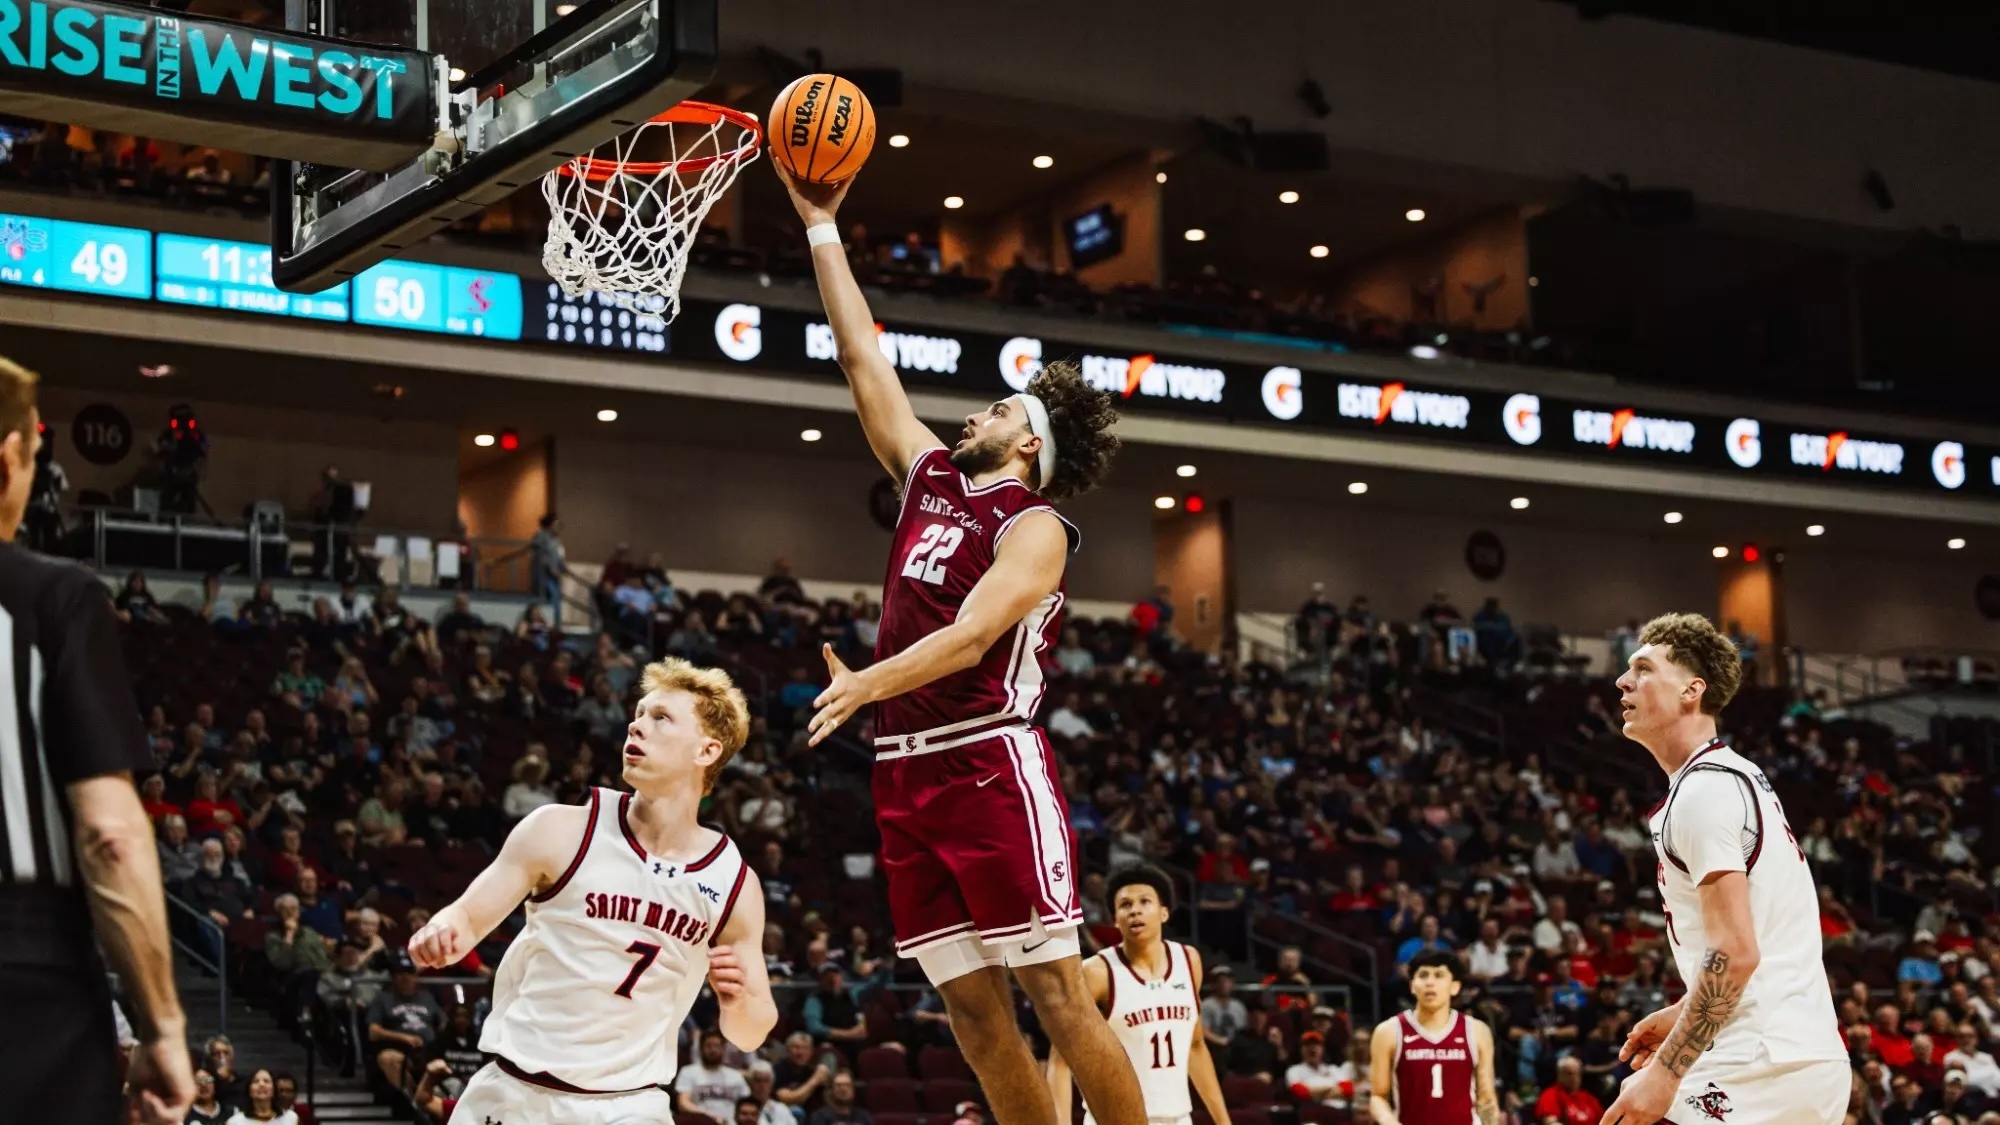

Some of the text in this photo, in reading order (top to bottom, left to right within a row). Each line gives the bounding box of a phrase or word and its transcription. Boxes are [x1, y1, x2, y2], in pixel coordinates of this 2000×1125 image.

[0, 0, 406, 119] RISE IN THE WEST
[791, 81, 825, 147] Wilson
[827, 95, 852, 146] NCAA
[71, 240, 128, 286] 49
[201, 244, 273, 288] 11:3
[375, 277, 425, 321] 50
[715, 304, 762, 361] G
[1261, 366, 1302, 420] G
[83, 422, 122, 449] 116
[1503, 393, 1541, 445] G
[1725, 418, 1761, 468] G
[1932, 441, 1965, 489] G
[920, 494, 954, 516] SANTA
[901, 524, 964, 585] 22
[698, 883, 720, 903] WCC
[585, 893, 708, 946] SAINT MARY'S
[614, 940, 661, 999] 7
[1124, 1008, 1152, 1028] SAINT
[1150, 1030, 1176, 1069] 11
[1431, 1063, 1444, 1098] 1
